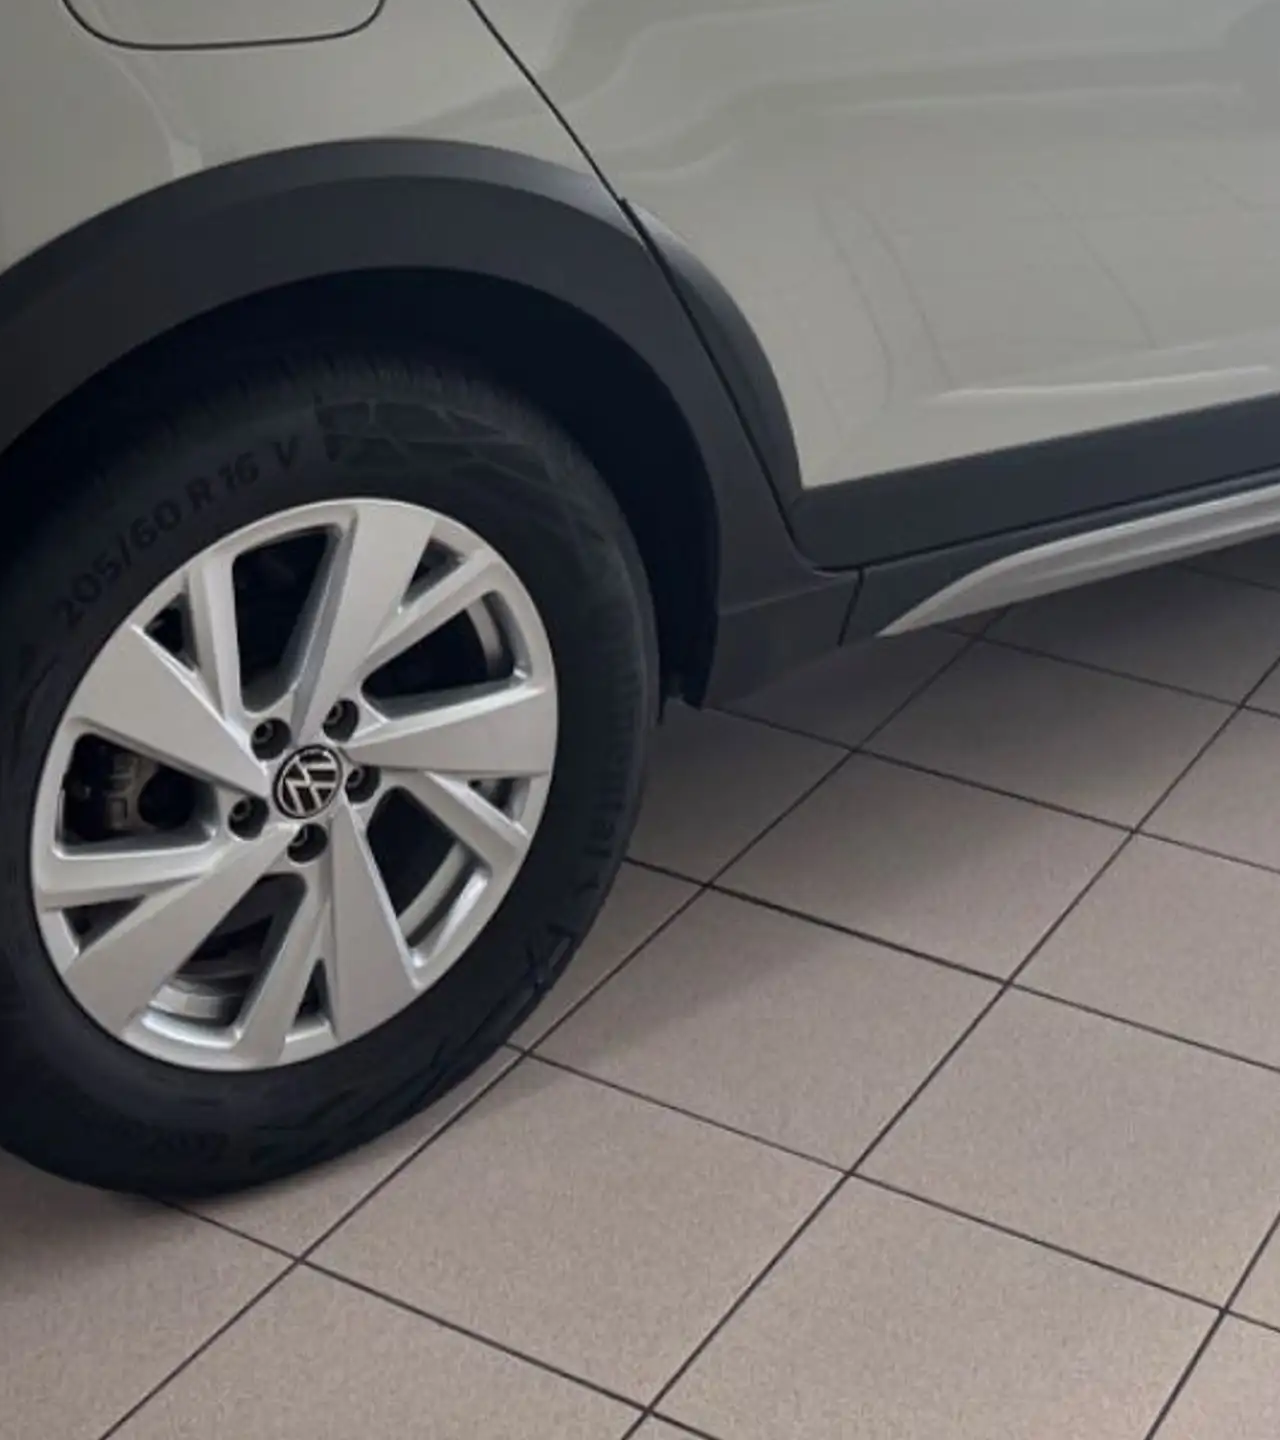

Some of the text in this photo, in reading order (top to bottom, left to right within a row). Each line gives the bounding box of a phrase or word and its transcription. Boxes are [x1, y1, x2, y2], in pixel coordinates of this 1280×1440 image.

[52, 498, 182, 628] 205/60
[184, 475, 214, 512] R
[218, 450, 260, 491] 16
